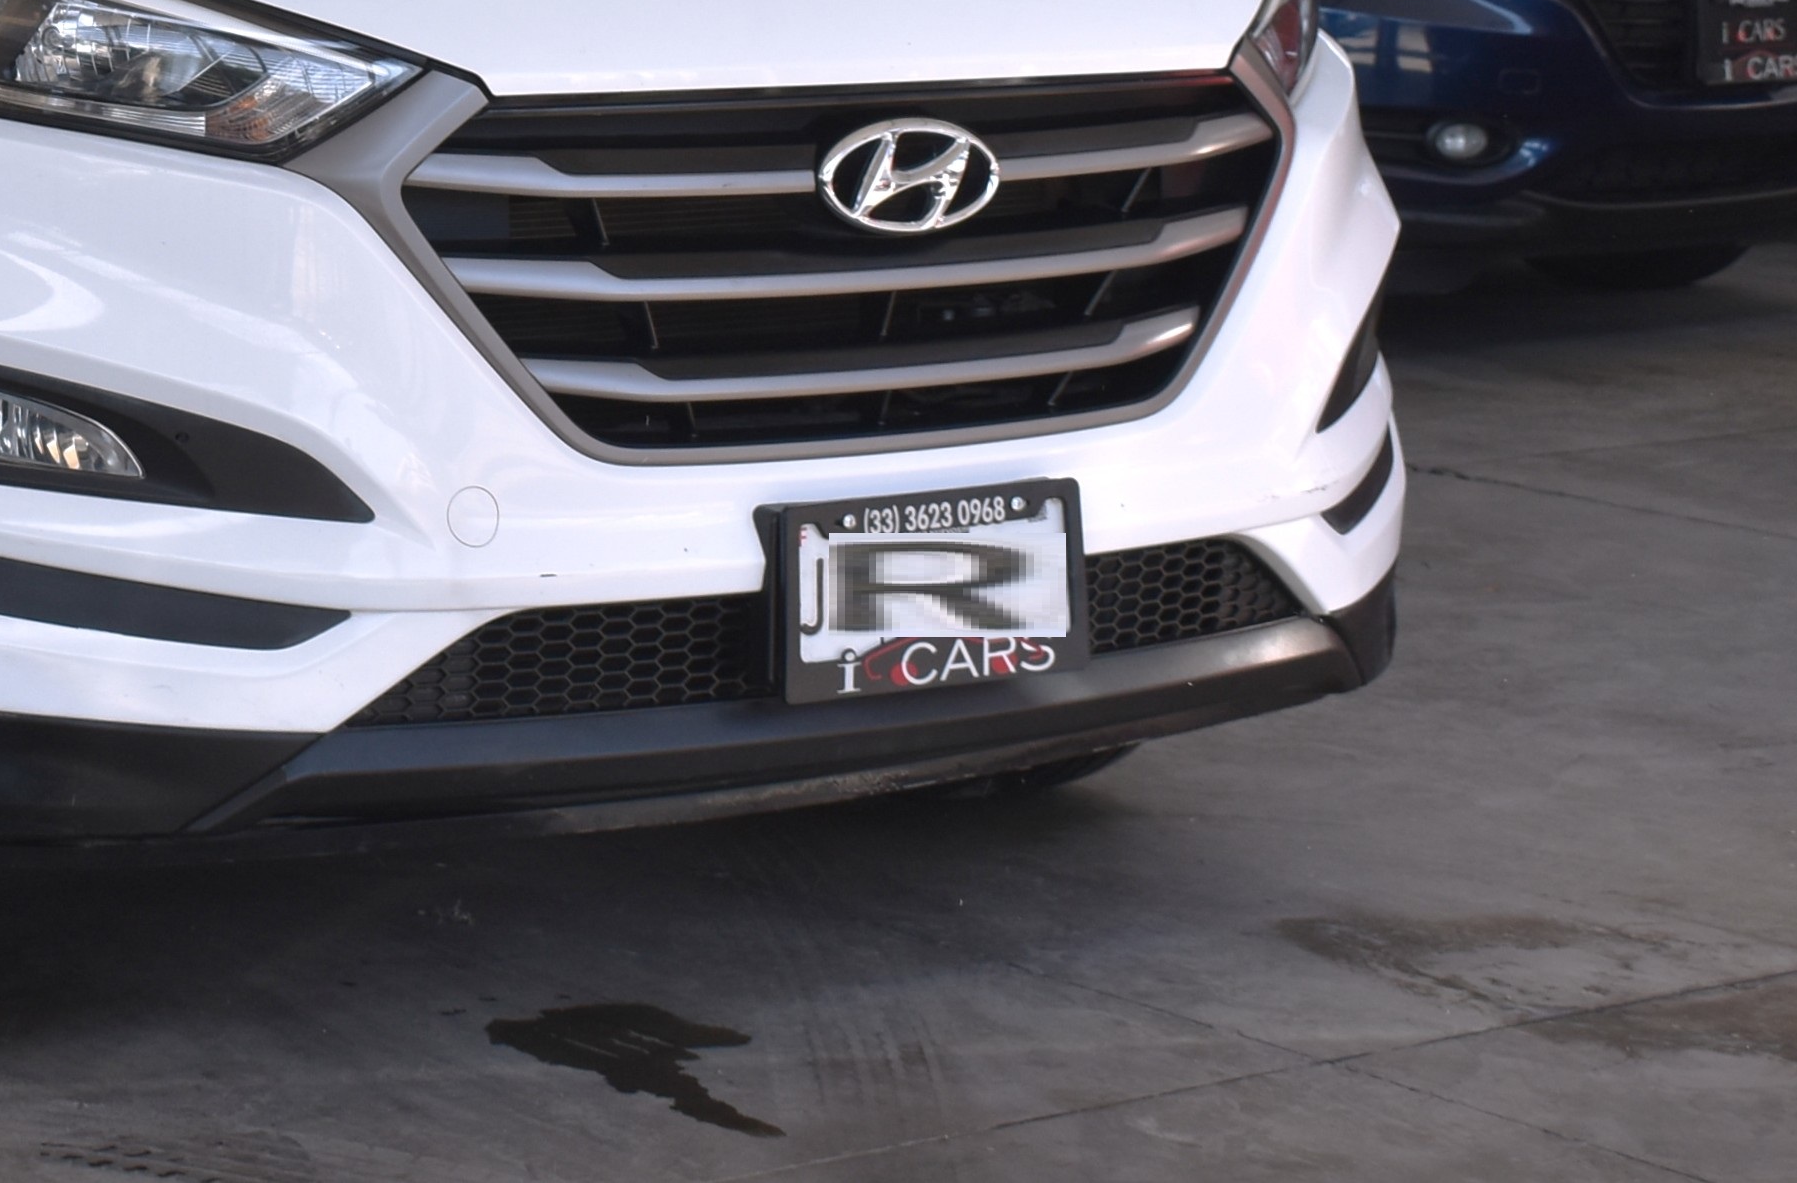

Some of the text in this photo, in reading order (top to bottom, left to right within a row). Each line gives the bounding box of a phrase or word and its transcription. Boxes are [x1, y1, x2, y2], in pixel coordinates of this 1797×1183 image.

[1737, 19, 1786, 43] CARS
[1747, 54, 1797, 80] CAR
[863, 496, 1005, 534] (33) 3623 0968
[901, 636, 1055, 685] CARS
